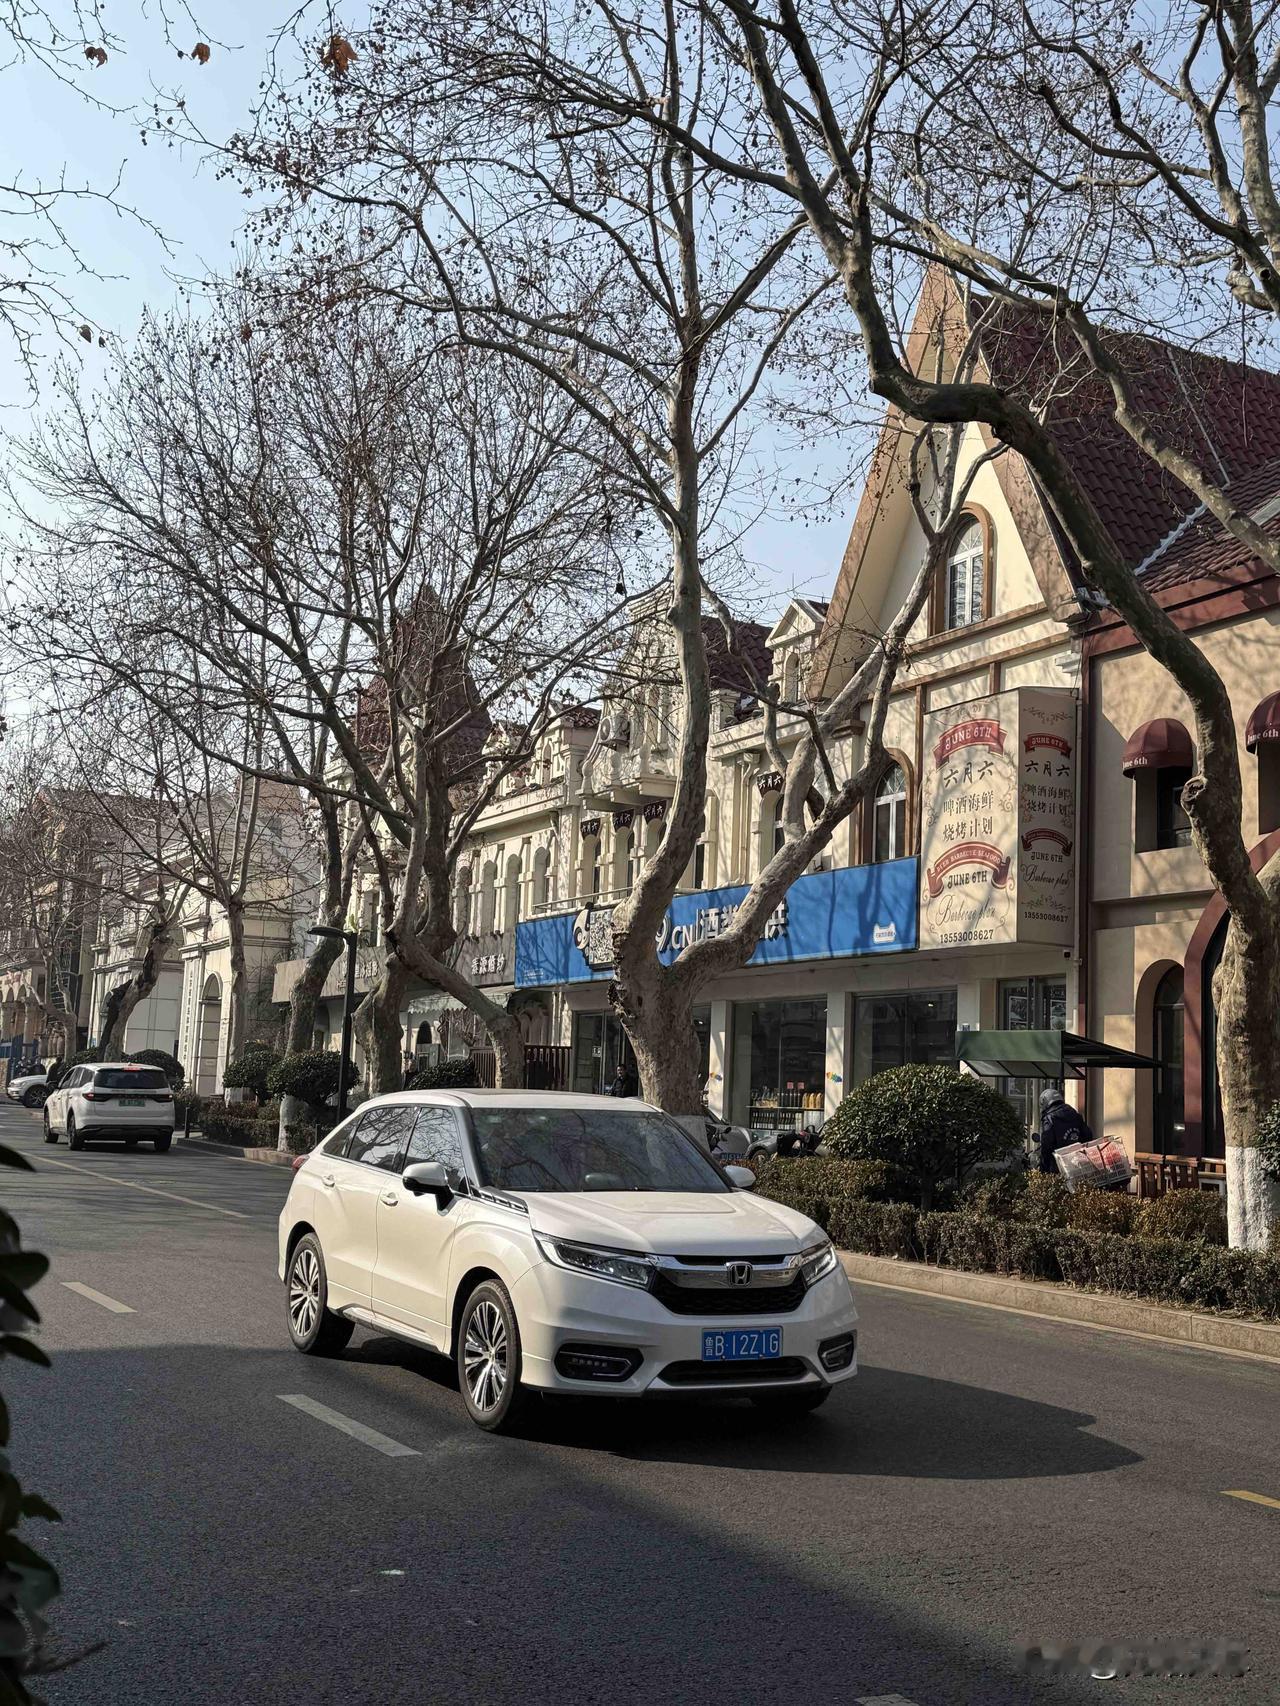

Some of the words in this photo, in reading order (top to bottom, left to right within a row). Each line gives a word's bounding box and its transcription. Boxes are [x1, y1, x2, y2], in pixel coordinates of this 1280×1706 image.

[945, 729, 972, 750] JUNE
[974, 727, 992, 738] 6TH
[1031, 737, 1050, 745] JUNE
[1262, 728, 1279, 738] 6th
[1025, 760, 1071, 777] 六月六
[1134, 756, 1148, 765] 6th
[944, 760, 994, 788] 六月六
[943, 791, 994, 817] 啤酒海鲜
[943, 816, 993, 842] 烧烤计划
[1031, 851, 1050, 861] JUNE
[1050, 854, 1063, 863] 6TH
[947, 872, 970, 889] JUNE
[971, 870, 988, 884] 6TH
[940, 929, 994, 944] 13553008627
